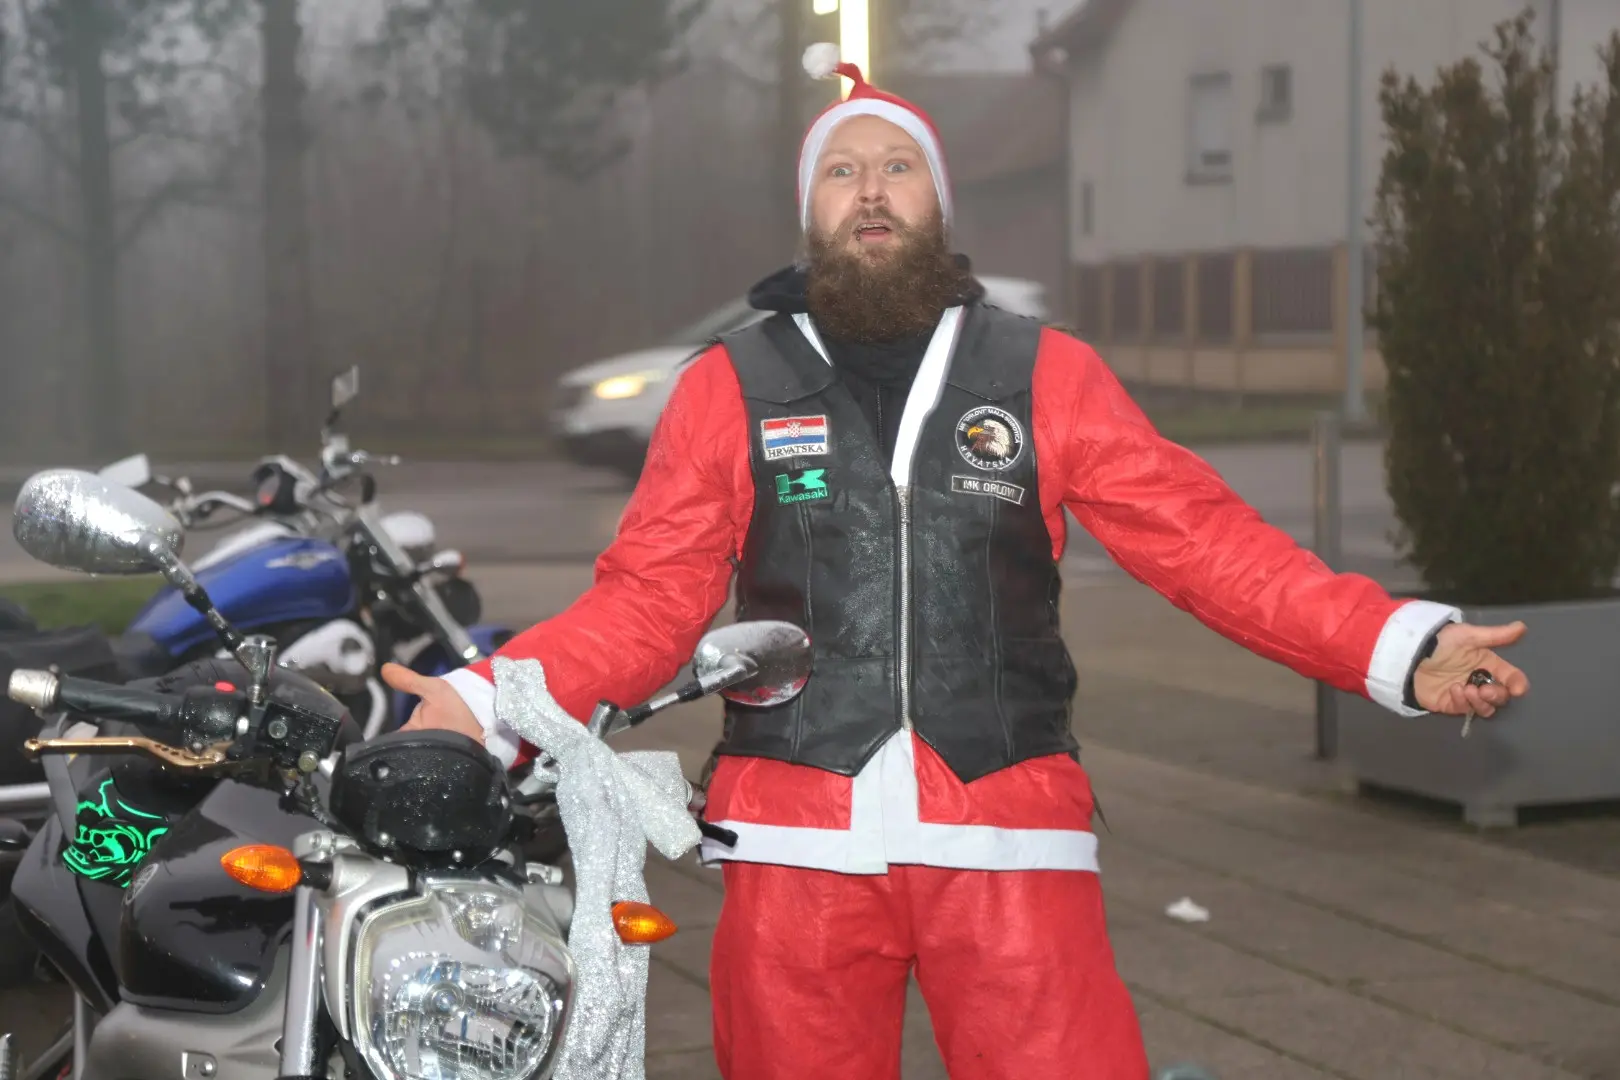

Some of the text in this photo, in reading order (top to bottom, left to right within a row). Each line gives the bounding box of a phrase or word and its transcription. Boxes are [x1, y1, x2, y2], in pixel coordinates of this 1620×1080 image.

[767, 444, 824, 459] HRVATSKA
[960, 445, 1012, 468] HRVATSKA
[779, 487, 828, 504] Kawasaki
[963, 479, 1016, 498] MK ORLOVI
